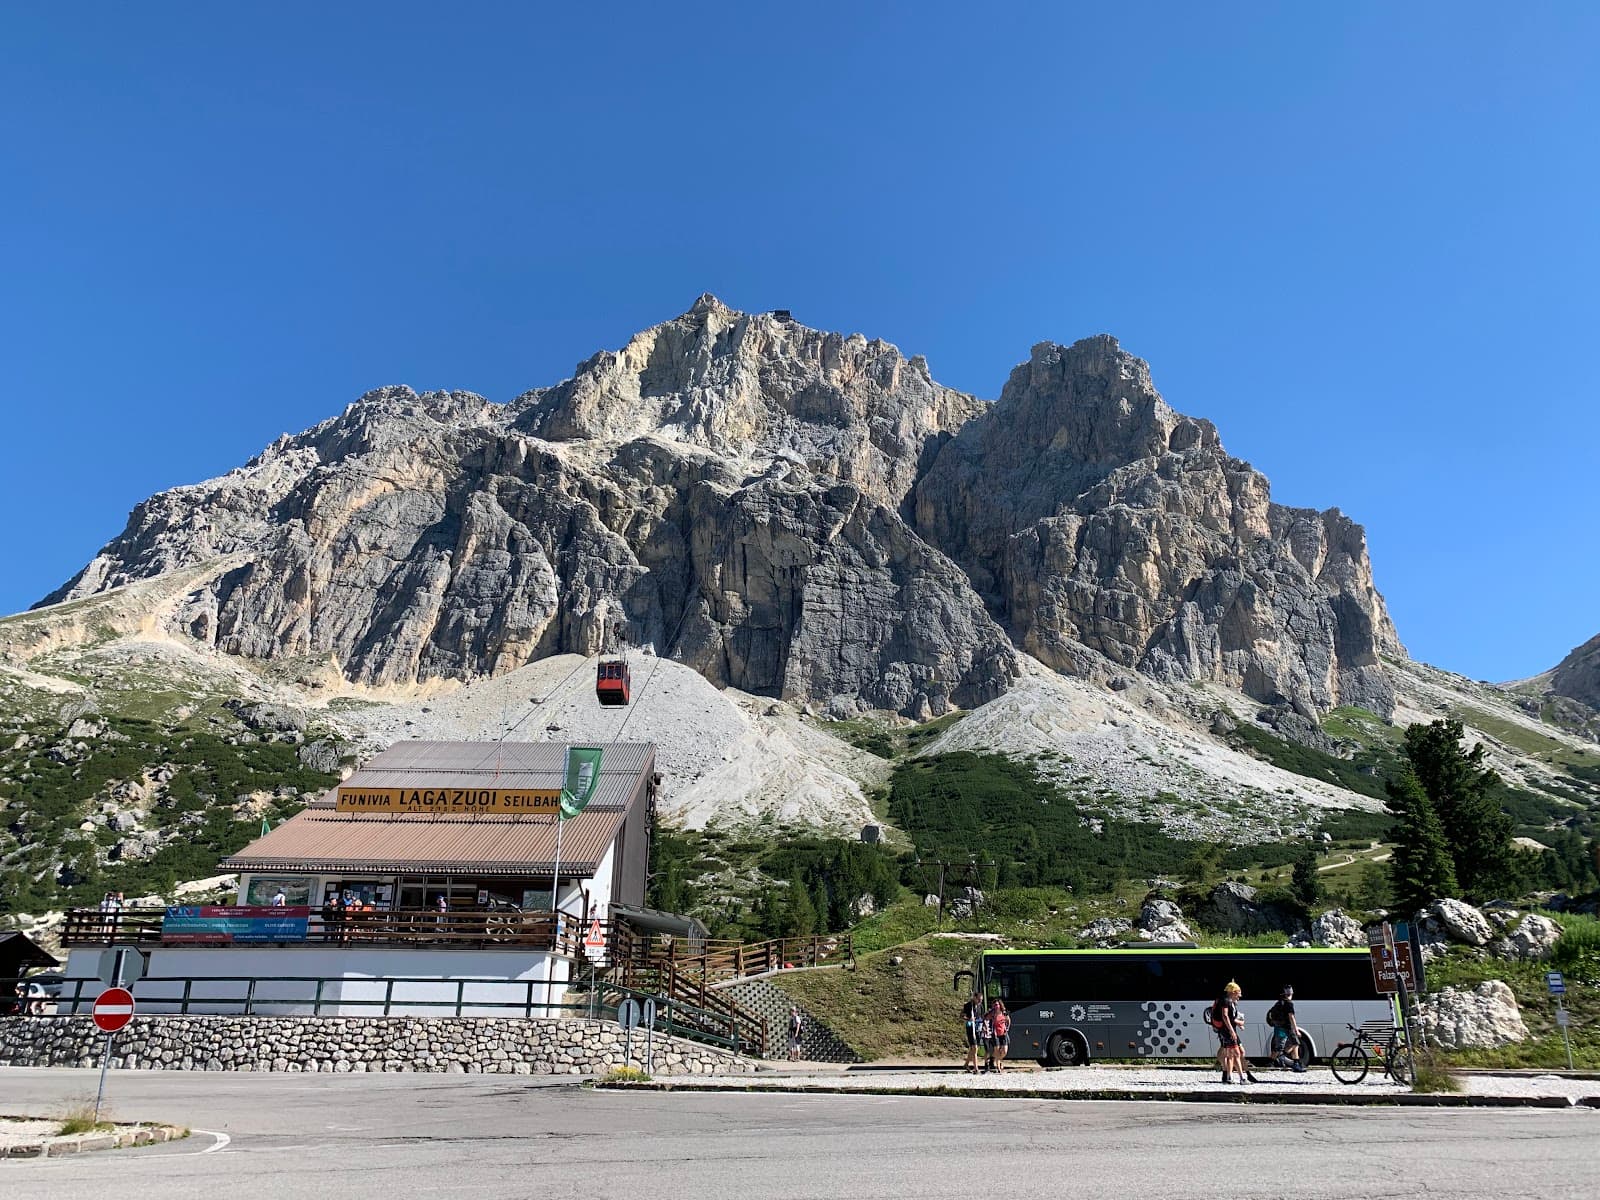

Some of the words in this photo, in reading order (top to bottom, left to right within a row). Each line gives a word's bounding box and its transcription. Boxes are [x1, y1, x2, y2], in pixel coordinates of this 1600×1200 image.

[341, 794, 390, 806] FUNIVIA
[399, 790, 497, 805] LAGAZUOI
[503, 795, 559, 807] SEILBAH
[1383, 960, 1401, 970] paso
[1377, 970, 1410, 981] Falzago
